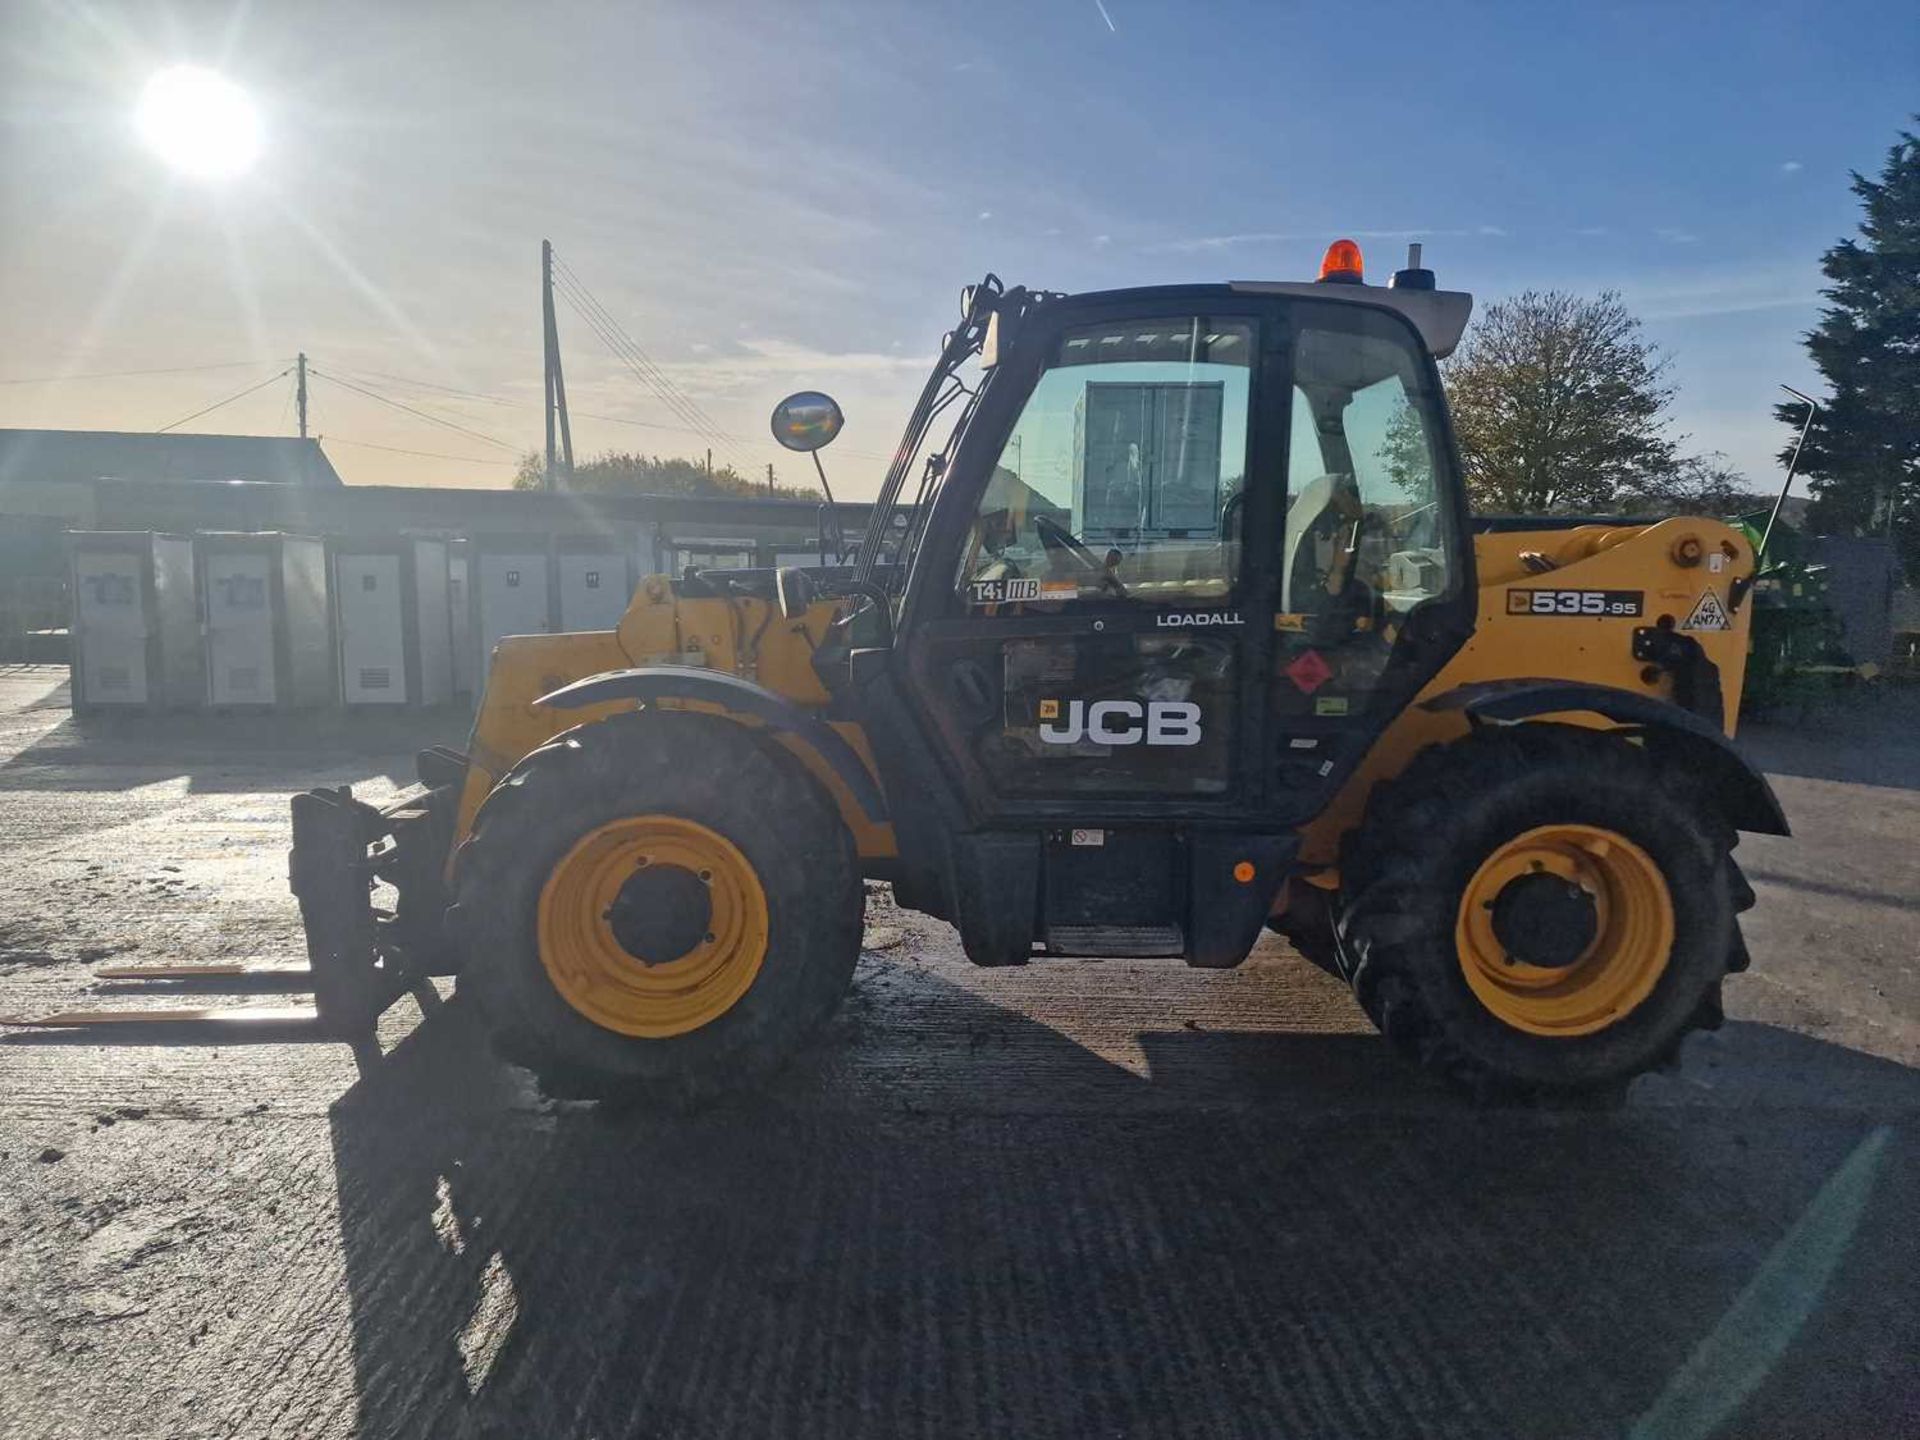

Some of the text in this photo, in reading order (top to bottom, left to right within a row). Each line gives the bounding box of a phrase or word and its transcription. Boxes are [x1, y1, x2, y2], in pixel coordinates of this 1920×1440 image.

[973, 583, 1003, 600] T4i
[1156, 612, 1245, 627] LOADALL
[1040, 700, 1202, 746] JCB
